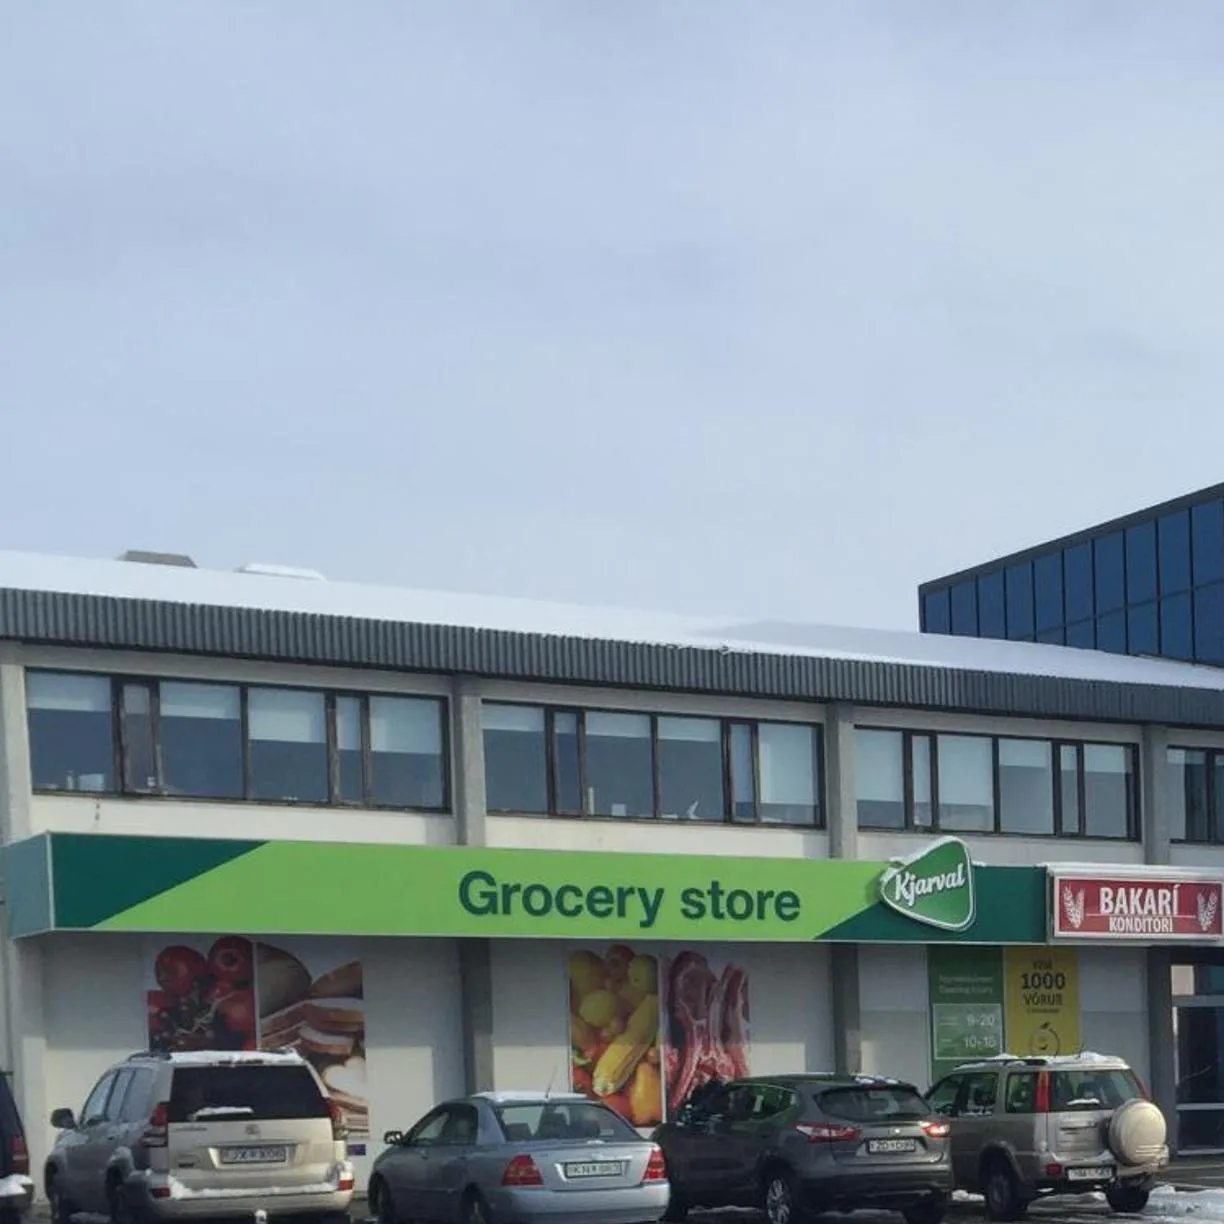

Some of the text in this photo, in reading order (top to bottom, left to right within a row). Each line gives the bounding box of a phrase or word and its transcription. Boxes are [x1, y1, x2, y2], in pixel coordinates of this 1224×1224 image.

[458, 869, 801, 928] Grocery store
[893, 862, 966, 907] Kjarval
[1099, 884, 1179, 916] BAKARÍ
[1108, 916, 1173, 933] KONDITORI
[1021, 972, 1066, 990] 1000
